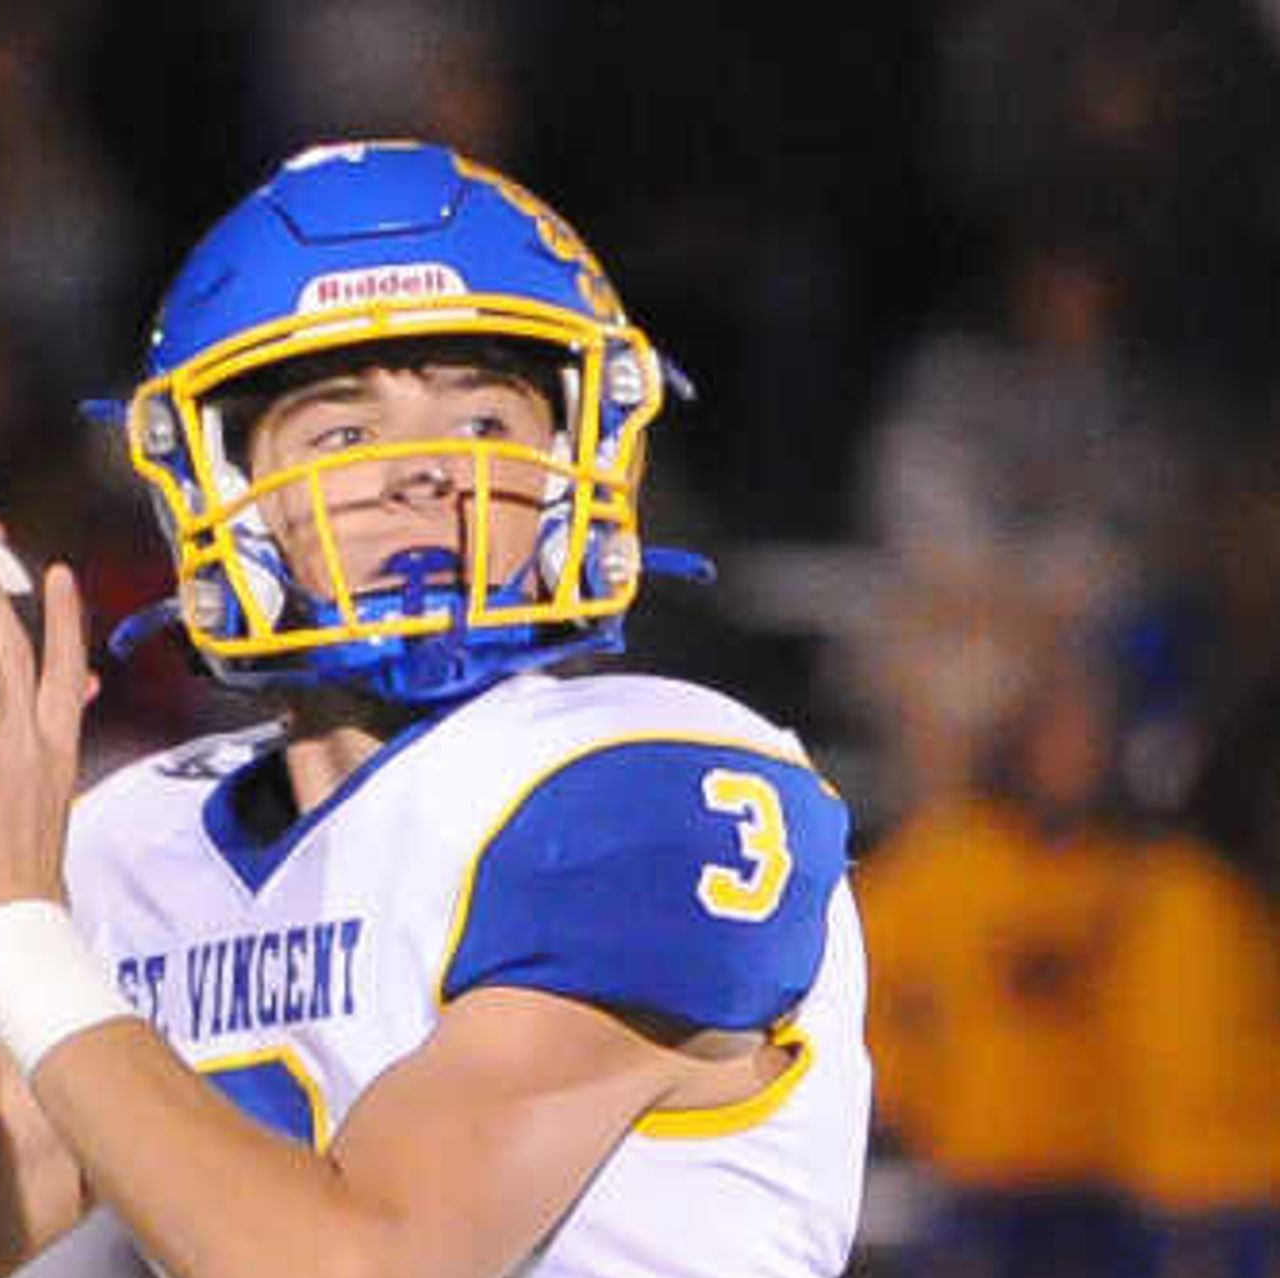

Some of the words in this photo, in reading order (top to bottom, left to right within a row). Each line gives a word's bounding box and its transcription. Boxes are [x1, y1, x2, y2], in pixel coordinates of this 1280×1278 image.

[317, 268, 445, 303] Riddell
[697, 768, 793, 922] 3
[186, 917, 363, 1041] VINCENT
